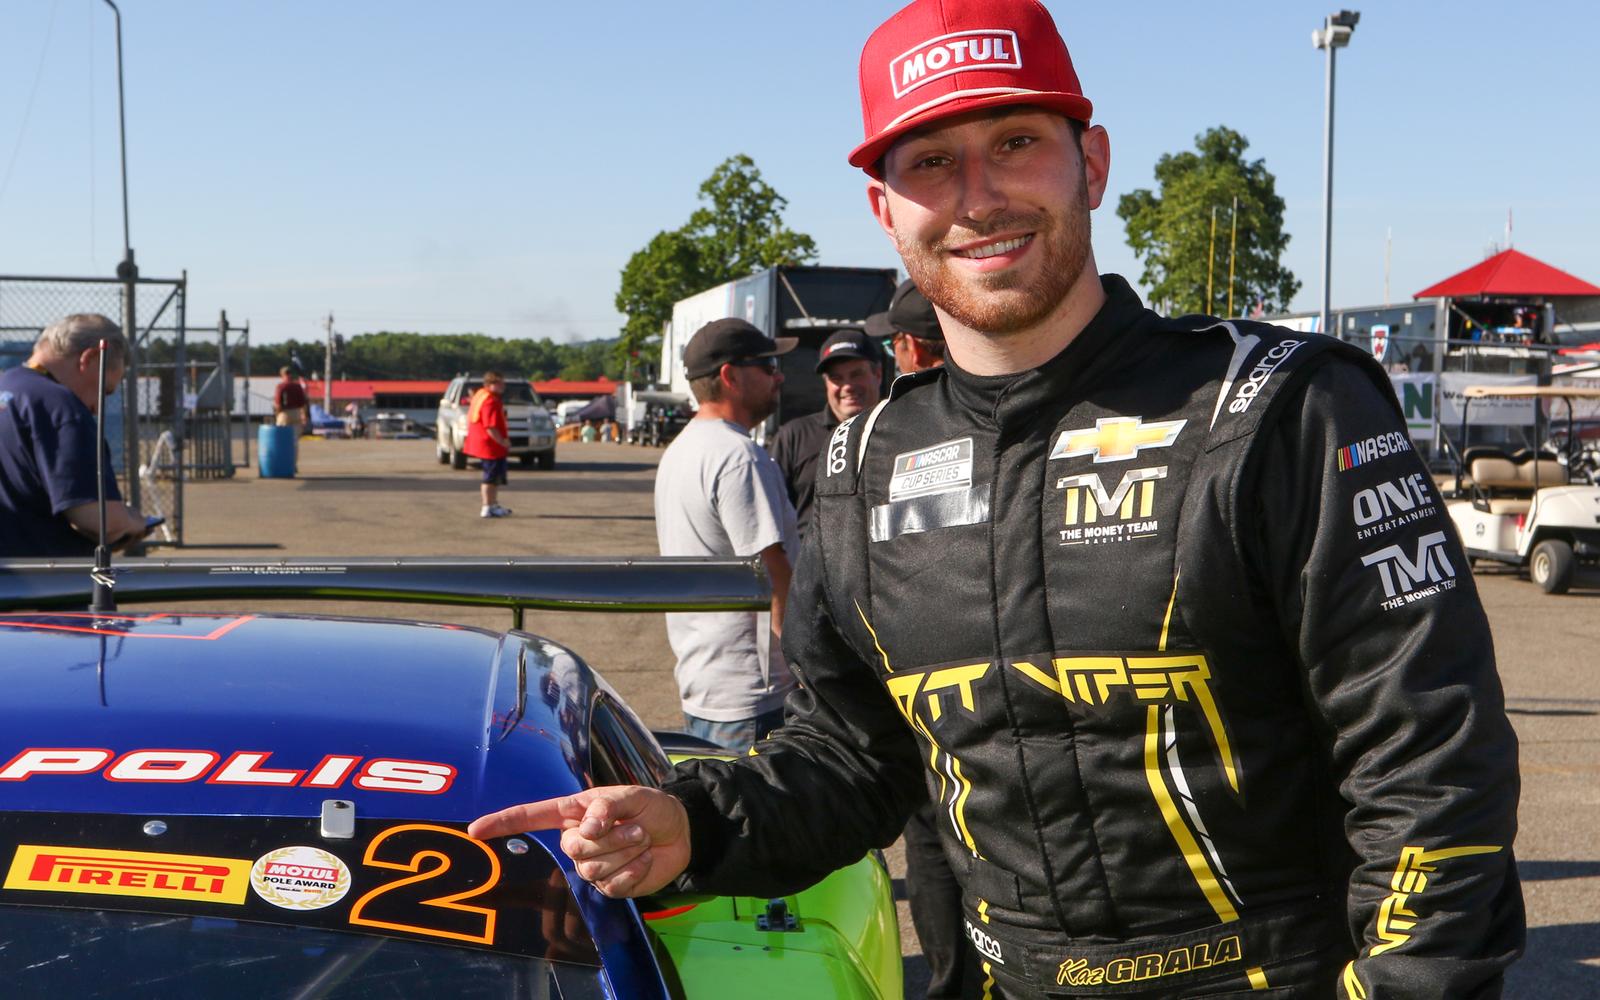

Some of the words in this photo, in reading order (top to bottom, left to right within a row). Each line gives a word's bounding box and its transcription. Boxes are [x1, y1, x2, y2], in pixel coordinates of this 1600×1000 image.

[902, 38, 1009, 86] MOTUL
[1228, 339, 1300, 414] sparco
[918, 445, 960, 466] NASCAR
[902, 475, 922, 489] CUP
[923, 466, 960, 485] SERIES
[1060, 529, 1082, 540] THE
[1084, 525, 1125, 537] MONEY
[1126, 520, 1158, 533] TEAM
[1357, 506, 1437, 540] ENTERTAINMENT
[1084, 535, 1131, 545] RACING
[1381, 595, 1405, 612] THE
[1405, 585, 1441, 603] MONEY
[0, 747, 458, 795] POLIS
[28, 854, 231, 894] PIRELLI
[263, 876, 293, 885] POLE
[294, 879, 336, 890] AWARD
[268, 864, 336, 880] MOTUL
[349, 823, 501, 945] 2
[1056, 958, 1104, 987] Kaz
[1105, 935, 1243, 985] GRALA
